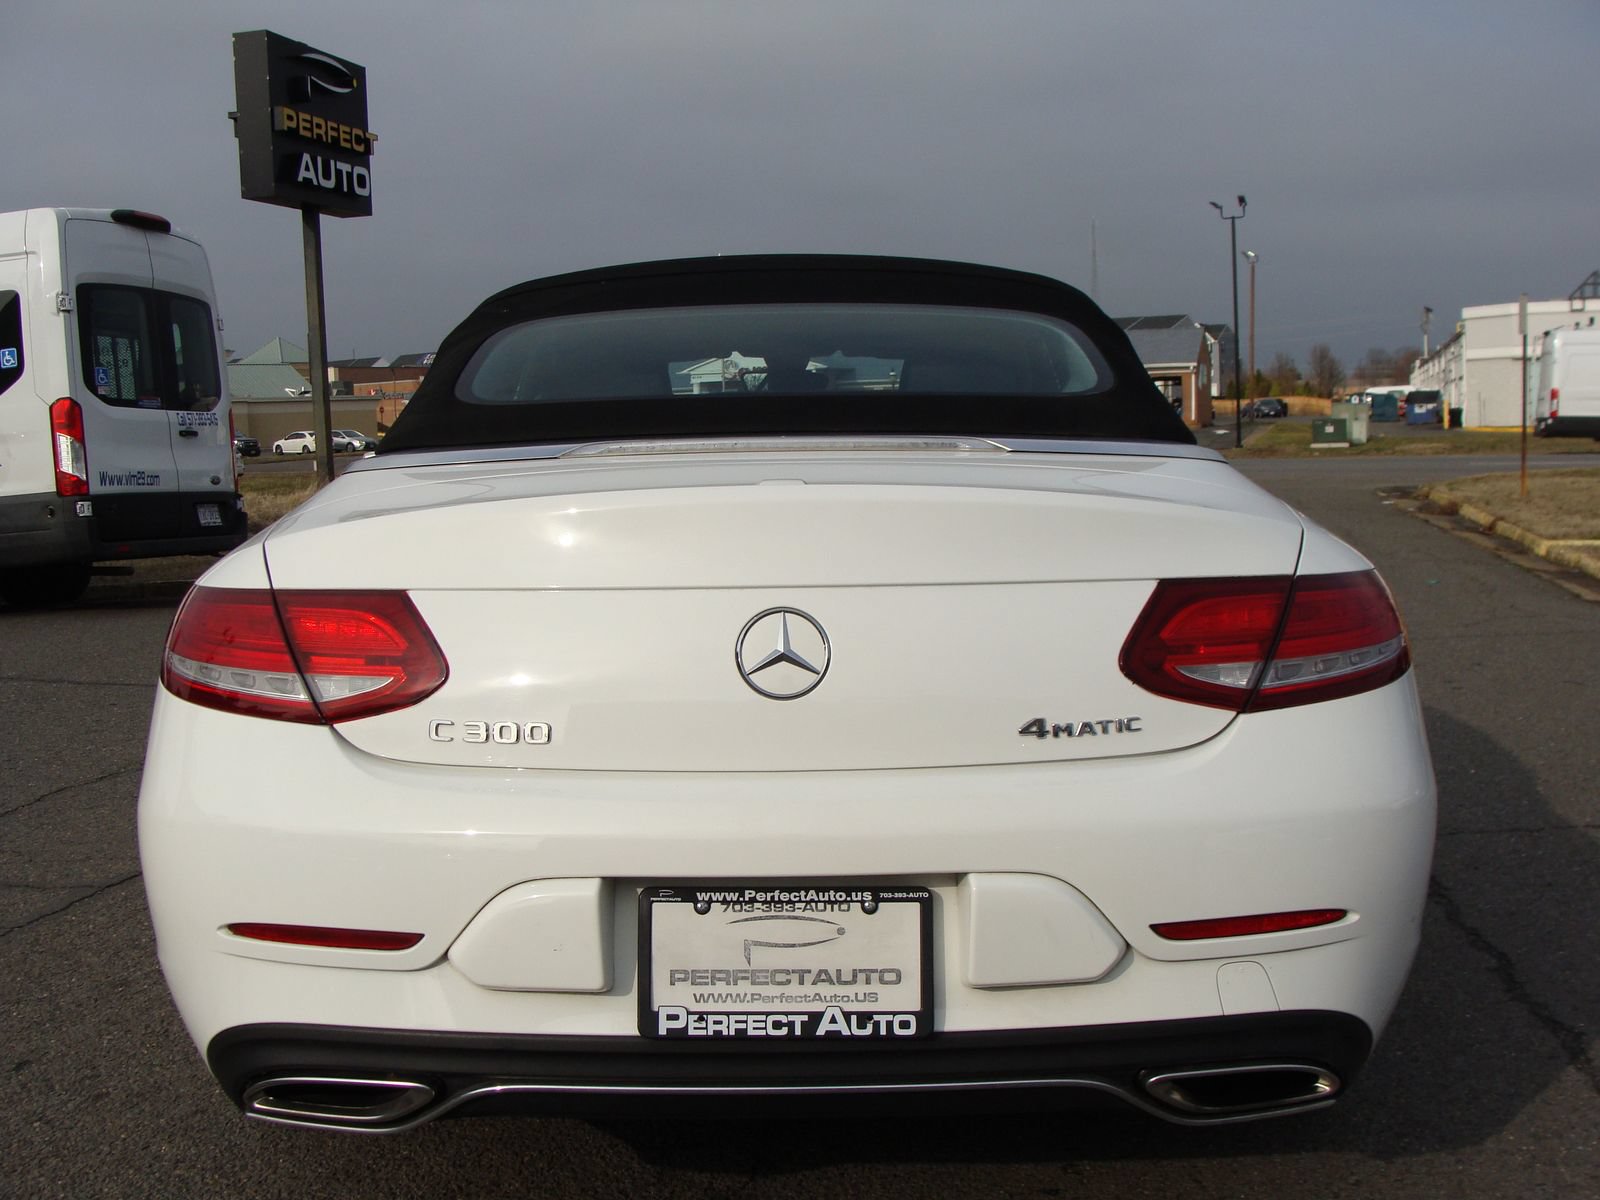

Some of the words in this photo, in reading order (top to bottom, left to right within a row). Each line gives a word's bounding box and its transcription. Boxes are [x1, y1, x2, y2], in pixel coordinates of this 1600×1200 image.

[282, 106, 379, 156] PERFECT
[297, 152, 371, 197] AUTO
[429, 719, 455, 742] C
[462, 721, 552, 745] 300
[1018, 716, 1143, 740] 4MATIC
[696, 889, 873, 902] www.PerfectAuto.us
[721, 902, 851, 913] 703-393-AUTO
[669, 968, 902, 986] PERFECTAUTO
[693, 992, 879, 1004] WWW.PerfectAuto.US
